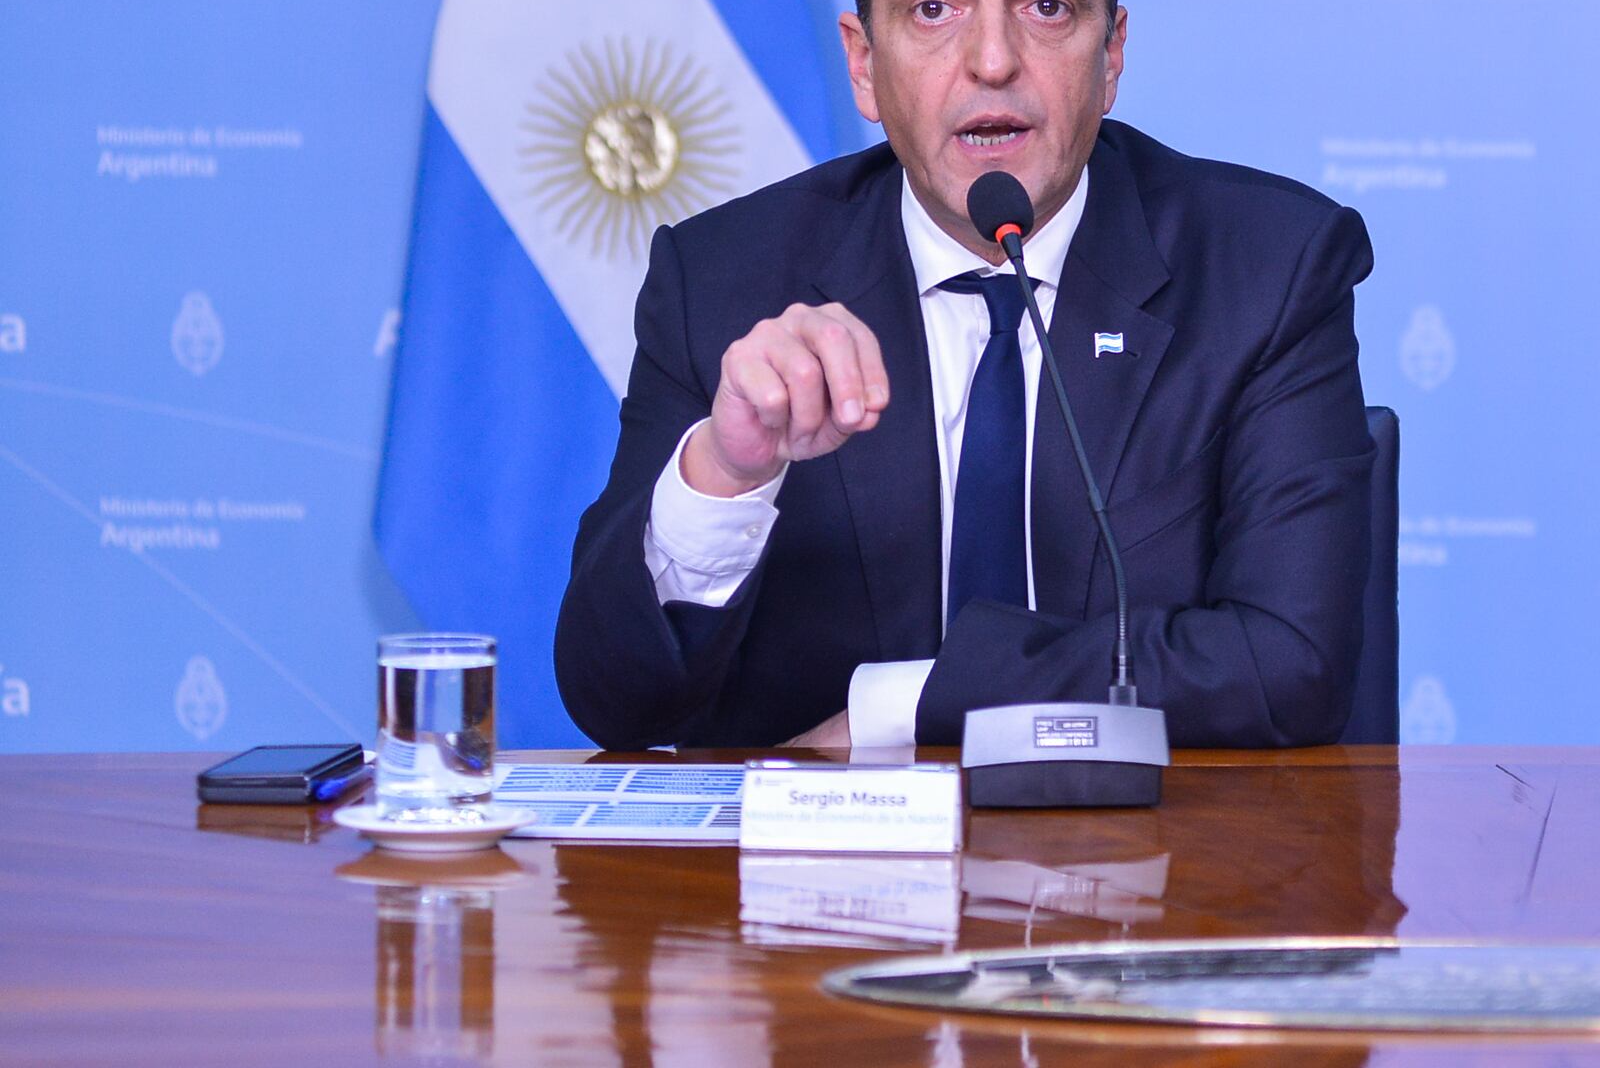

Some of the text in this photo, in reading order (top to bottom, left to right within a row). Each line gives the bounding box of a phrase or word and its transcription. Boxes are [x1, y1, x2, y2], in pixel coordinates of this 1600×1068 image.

[97, 151, 218, 182] Argentina
[1323, 163, 1448, 194] Argentina
[101, 521, 220, 554] Argentina
[788, 789, 908, 810] Sergio Massa
